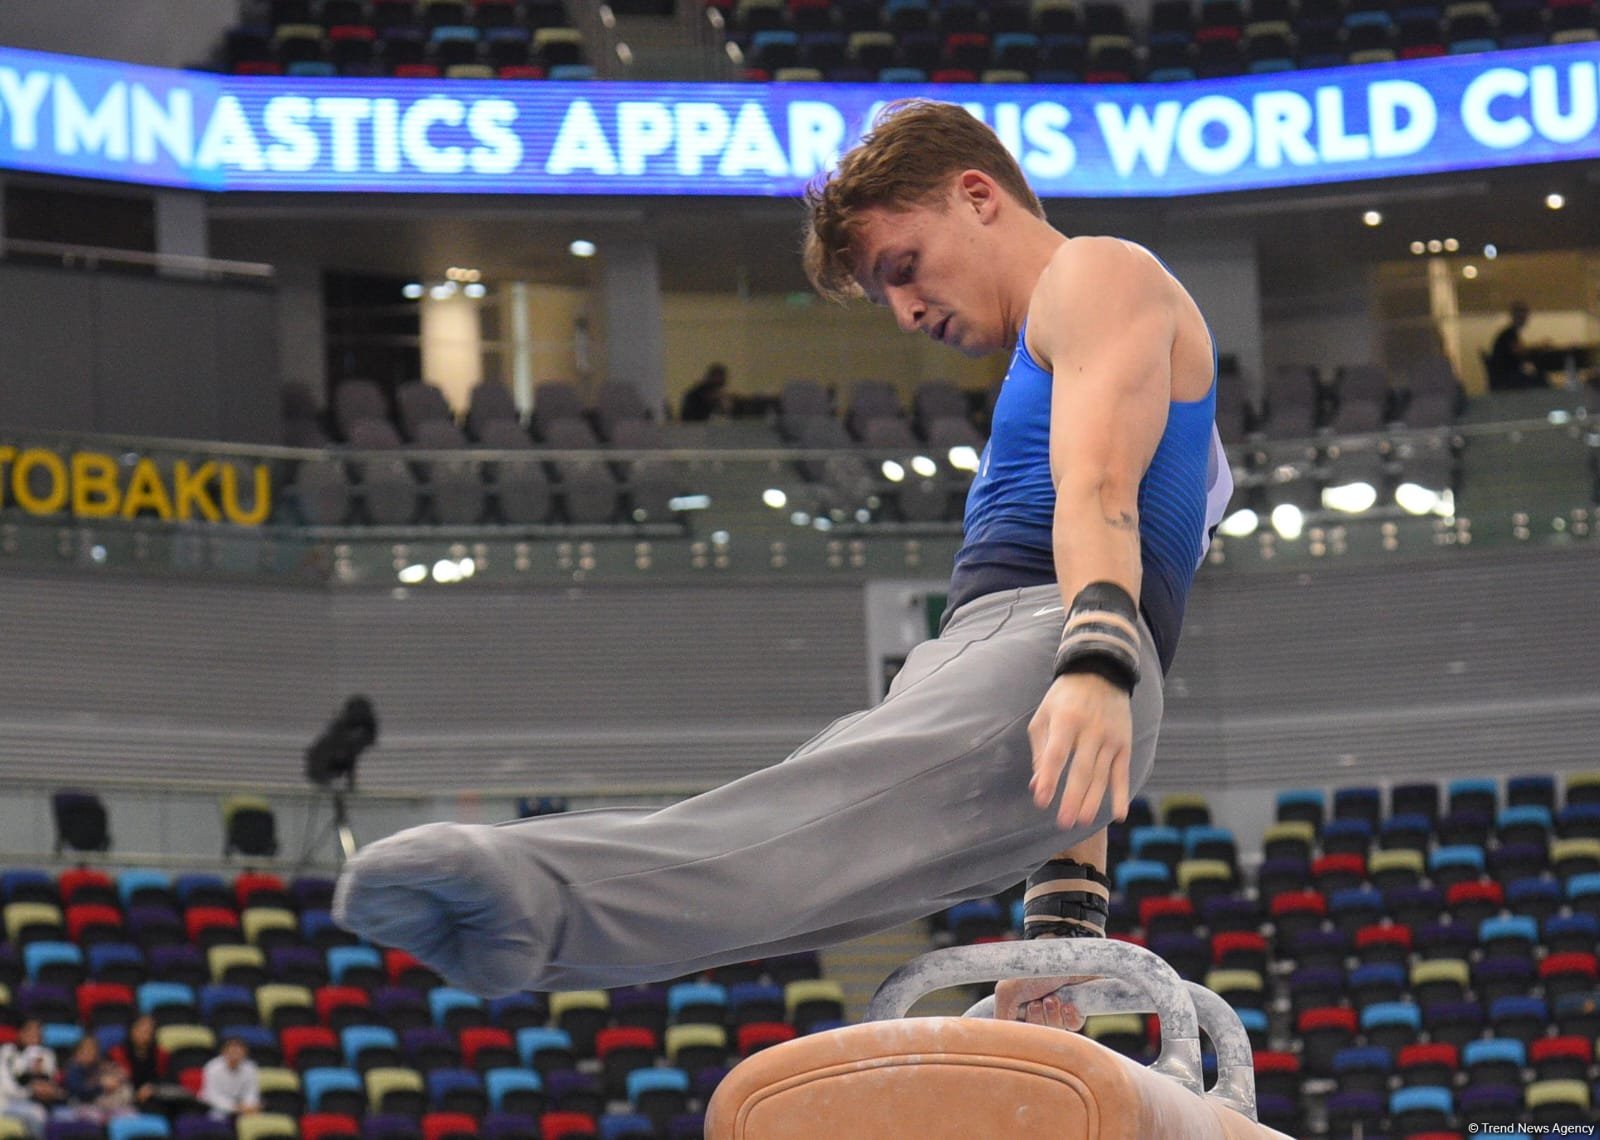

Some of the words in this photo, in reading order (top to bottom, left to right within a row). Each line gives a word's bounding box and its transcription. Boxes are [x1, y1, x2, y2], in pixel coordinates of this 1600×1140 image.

[0, 66, 524, 175] YMNASTICS
[545, 98, 1077, 178] APPARS
[1093, 79, 1438, 177] WORLD
[1460, 61, 1600, 149] CU
